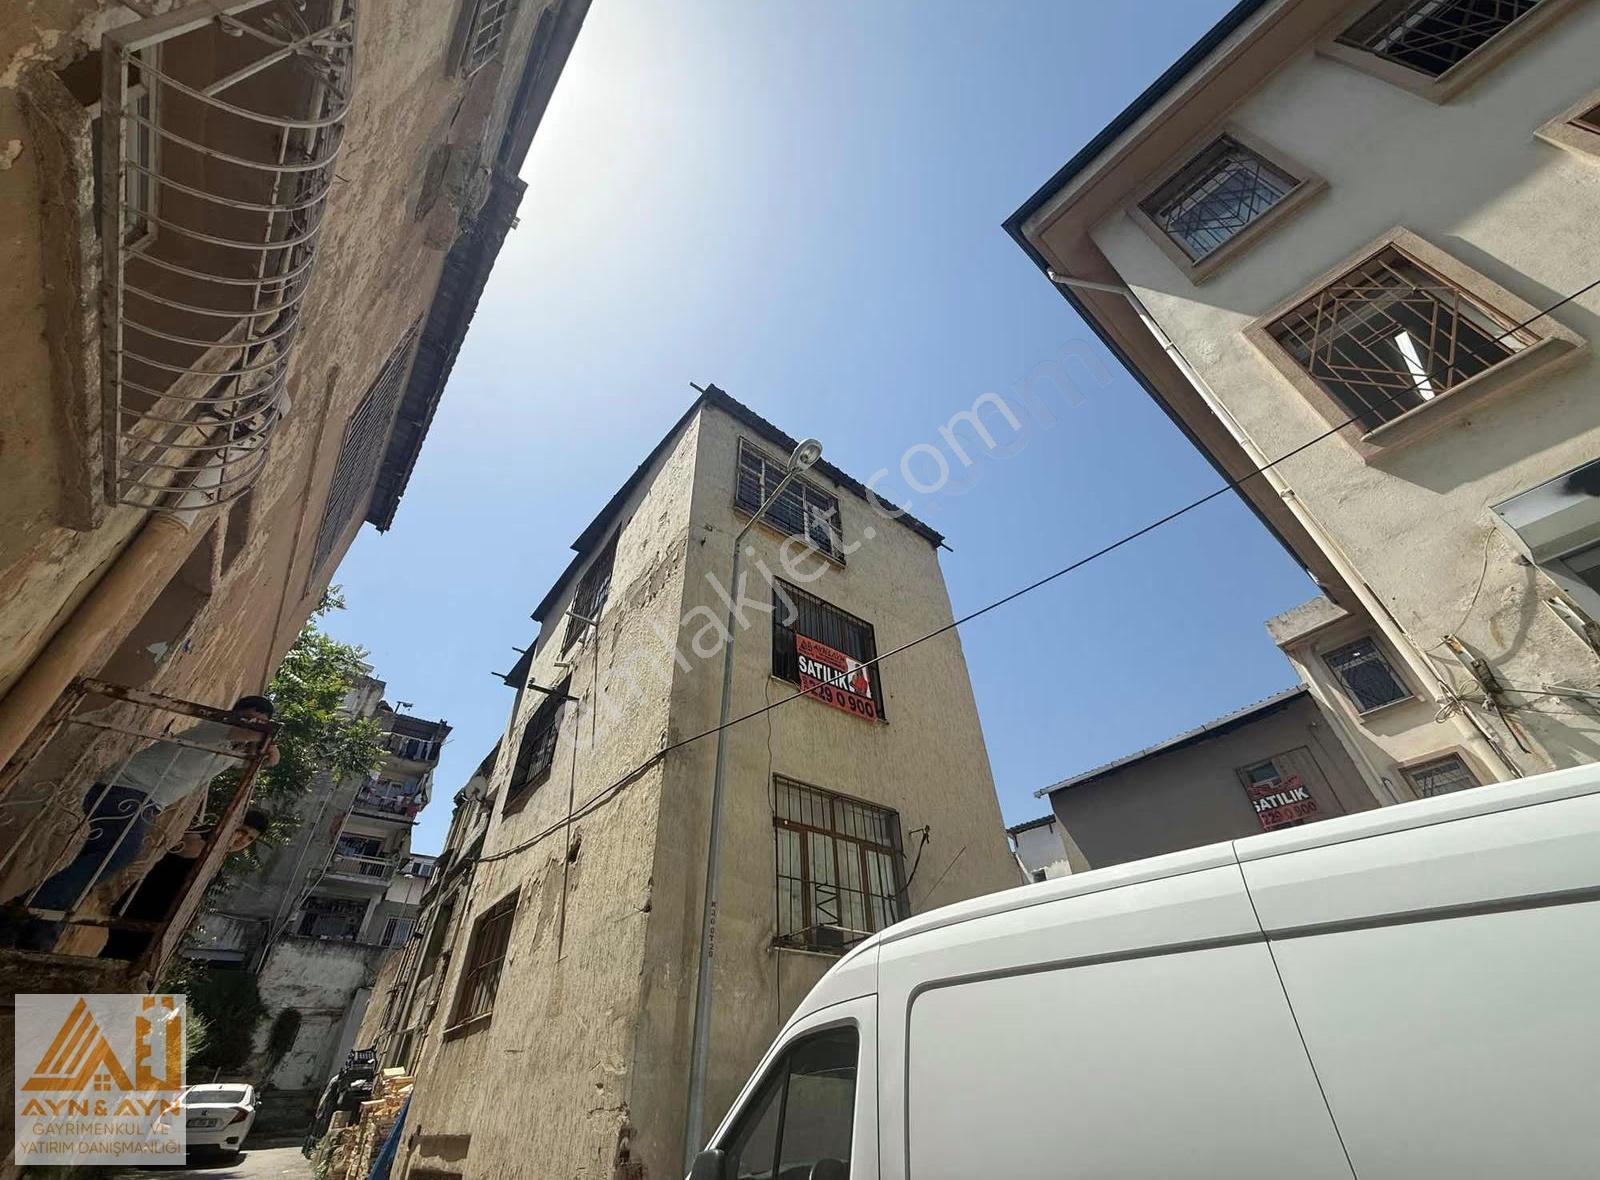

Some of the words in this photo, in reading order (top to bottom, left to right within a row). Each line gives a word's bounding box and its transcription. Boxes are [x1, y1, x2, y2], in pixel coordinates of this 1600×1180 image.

[798, 655, 849, 692] SATILIK
[836, 690, 846, 708] 0
[848, 697, 875, 718] 900
